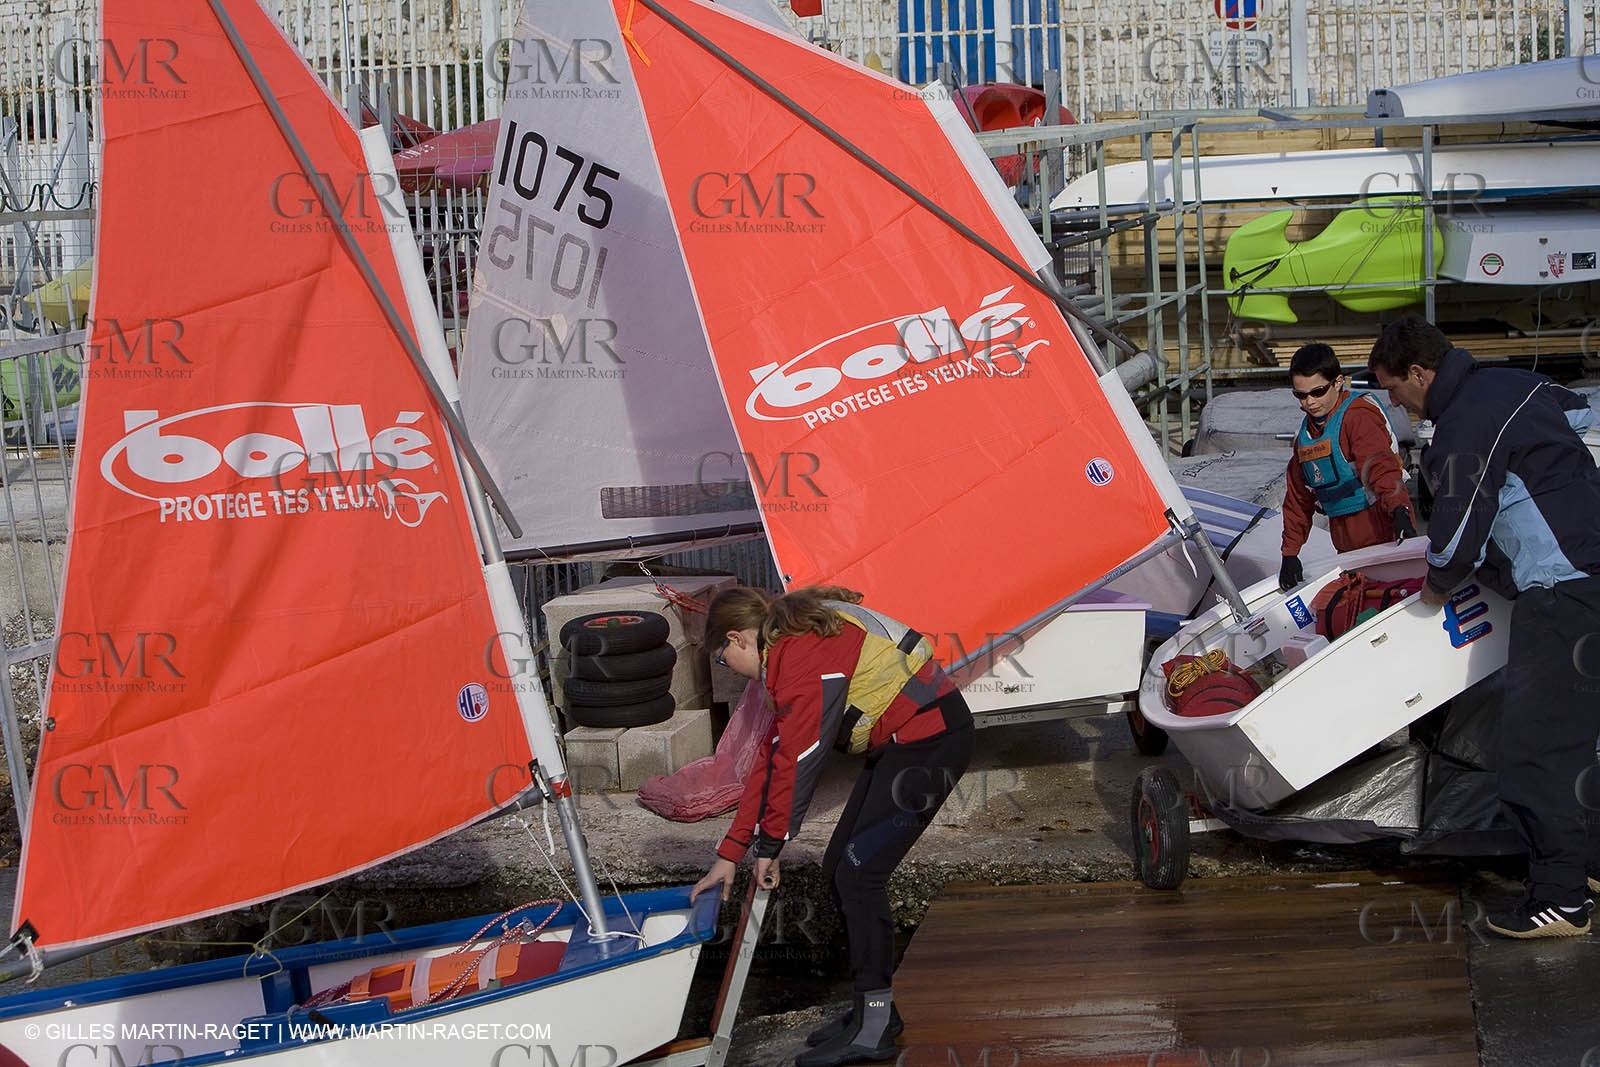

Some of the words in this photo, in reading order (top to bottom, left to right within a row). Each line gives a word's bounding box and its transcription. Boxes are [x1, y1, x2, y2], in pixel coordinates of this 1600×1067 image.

[498, 120, 620, 230] 1075
[747, 285, 1031, 408] bollé
[802, 383, 896, 430] PROTEGE
[891, 371, 929, 401] TES
[927, 356, 979, 386] YEUX
[108, 403, 435, 484] bollé
[159, 490, 267, 523] PROTEGE
[267, 487, 311, 515] TES
[313, 483, 380, 511] YEUX
